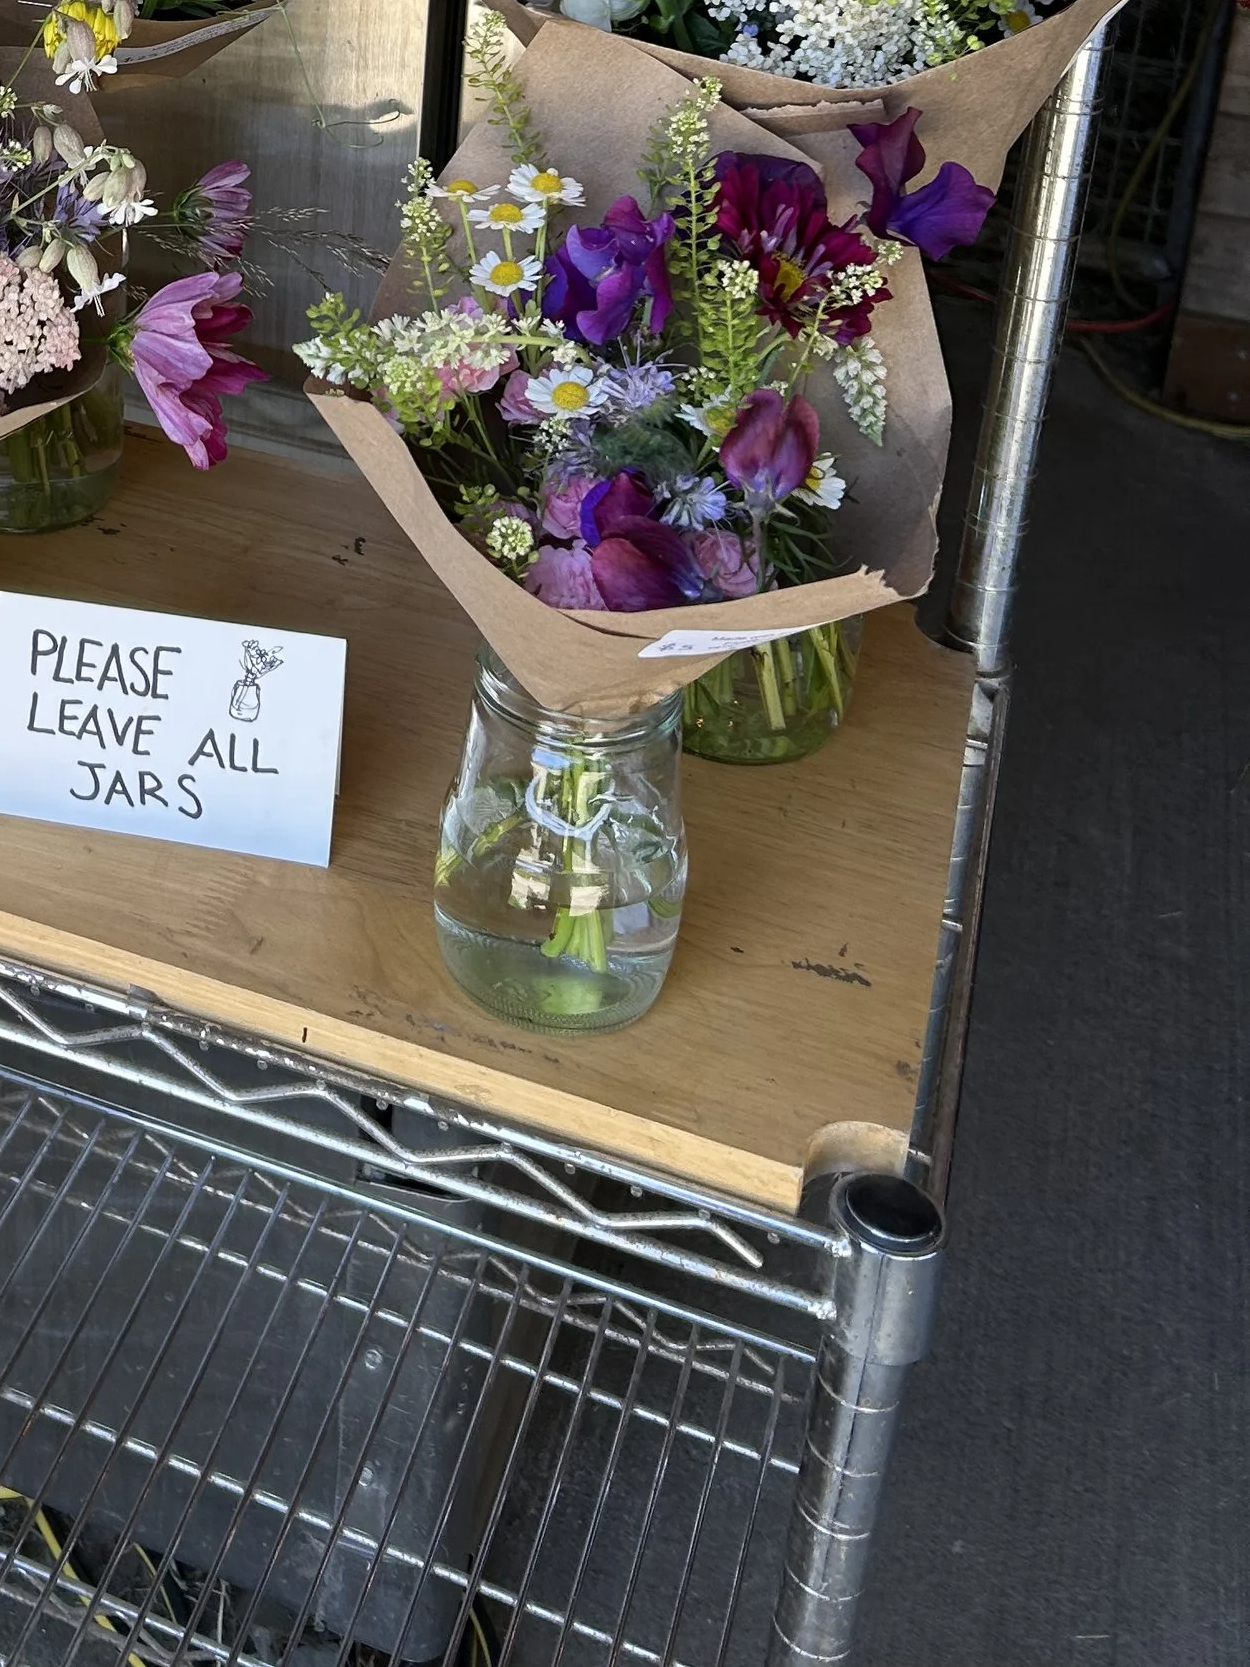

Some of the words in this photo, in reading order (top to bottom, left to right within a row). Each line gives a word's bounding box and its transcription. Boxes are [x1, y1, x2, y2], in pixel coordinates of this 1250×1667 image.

[31, 629, 182, 700] PLEASE
[27, 692, 162, 756] LEAVE
[188, 728, 279, 774] ALL
[69, 760, 203, 819] JARS
